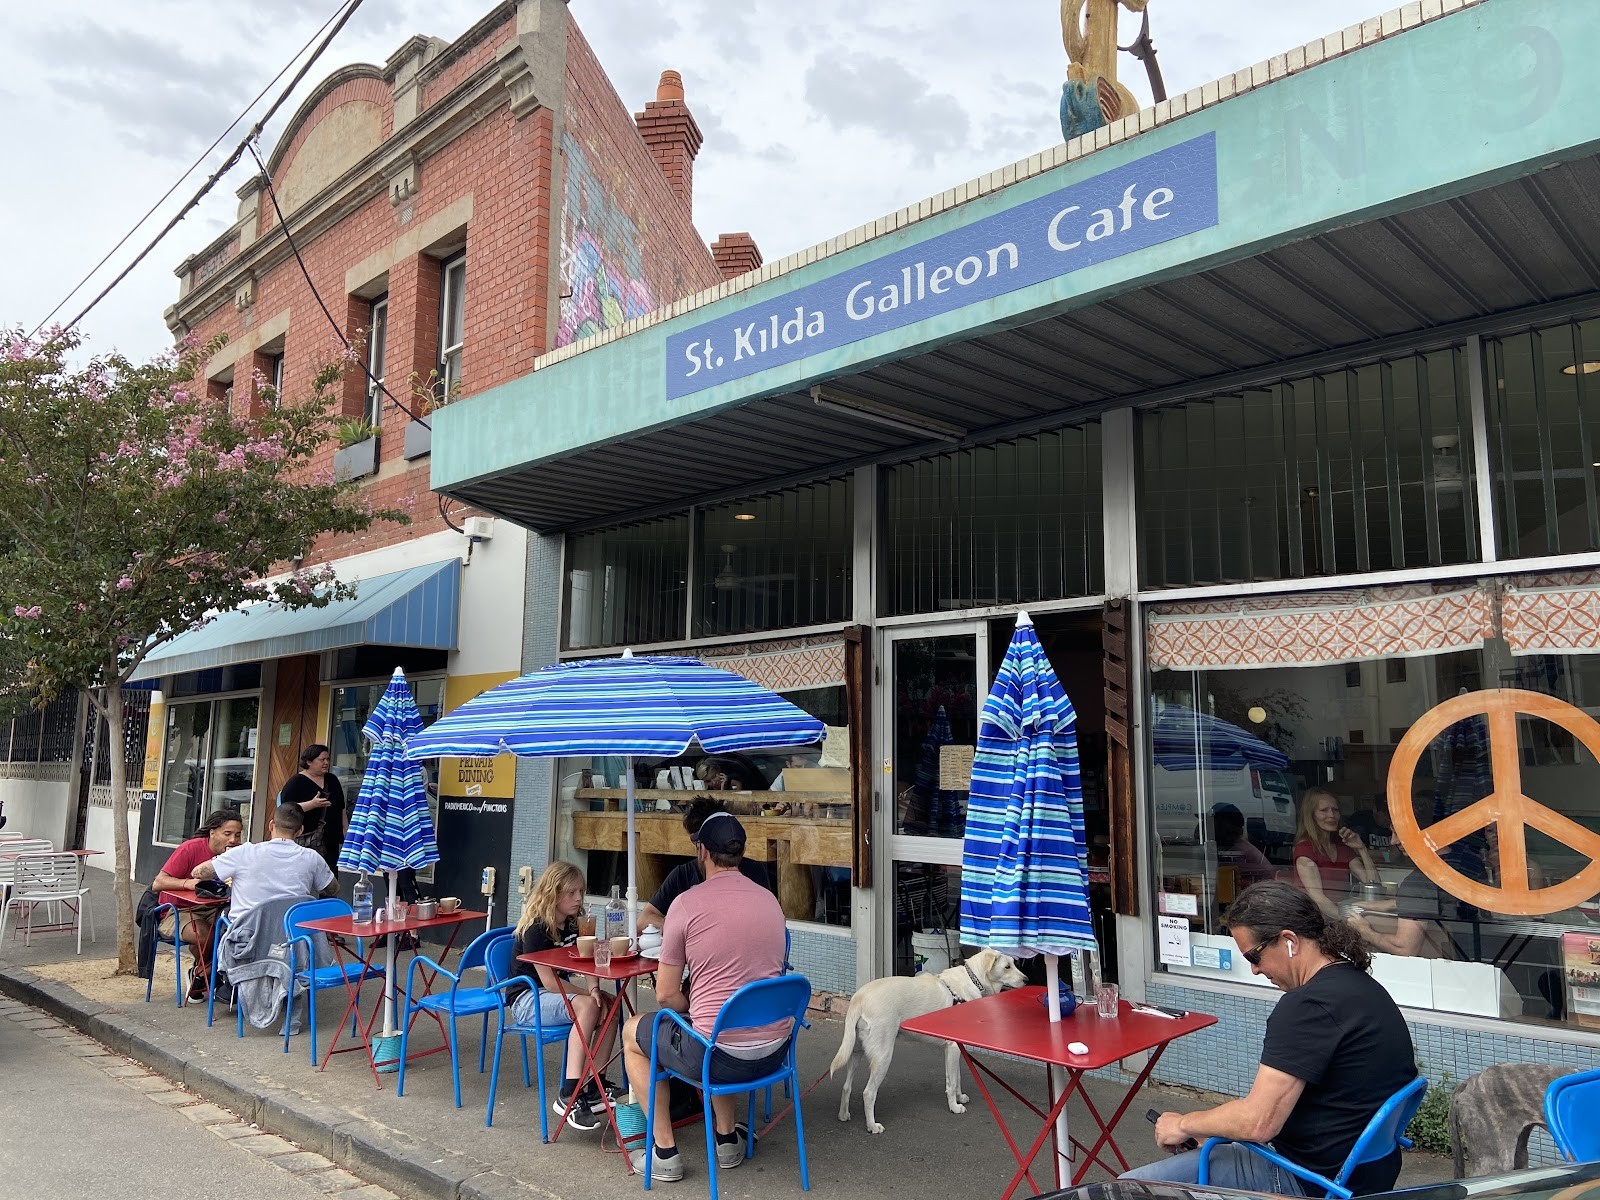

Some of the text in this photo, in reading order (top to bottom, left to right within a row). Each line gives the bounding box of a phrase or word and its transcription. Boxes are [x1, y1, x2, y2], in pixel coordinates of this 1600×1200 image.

[686, 184, 1174, 376] St. Kilda Galleon Cafe
[459, 757, 494, 768] PRIVATE
[458, 769, 494, 783] DINING
[1160, 923, 1187, 931] SMOKING
